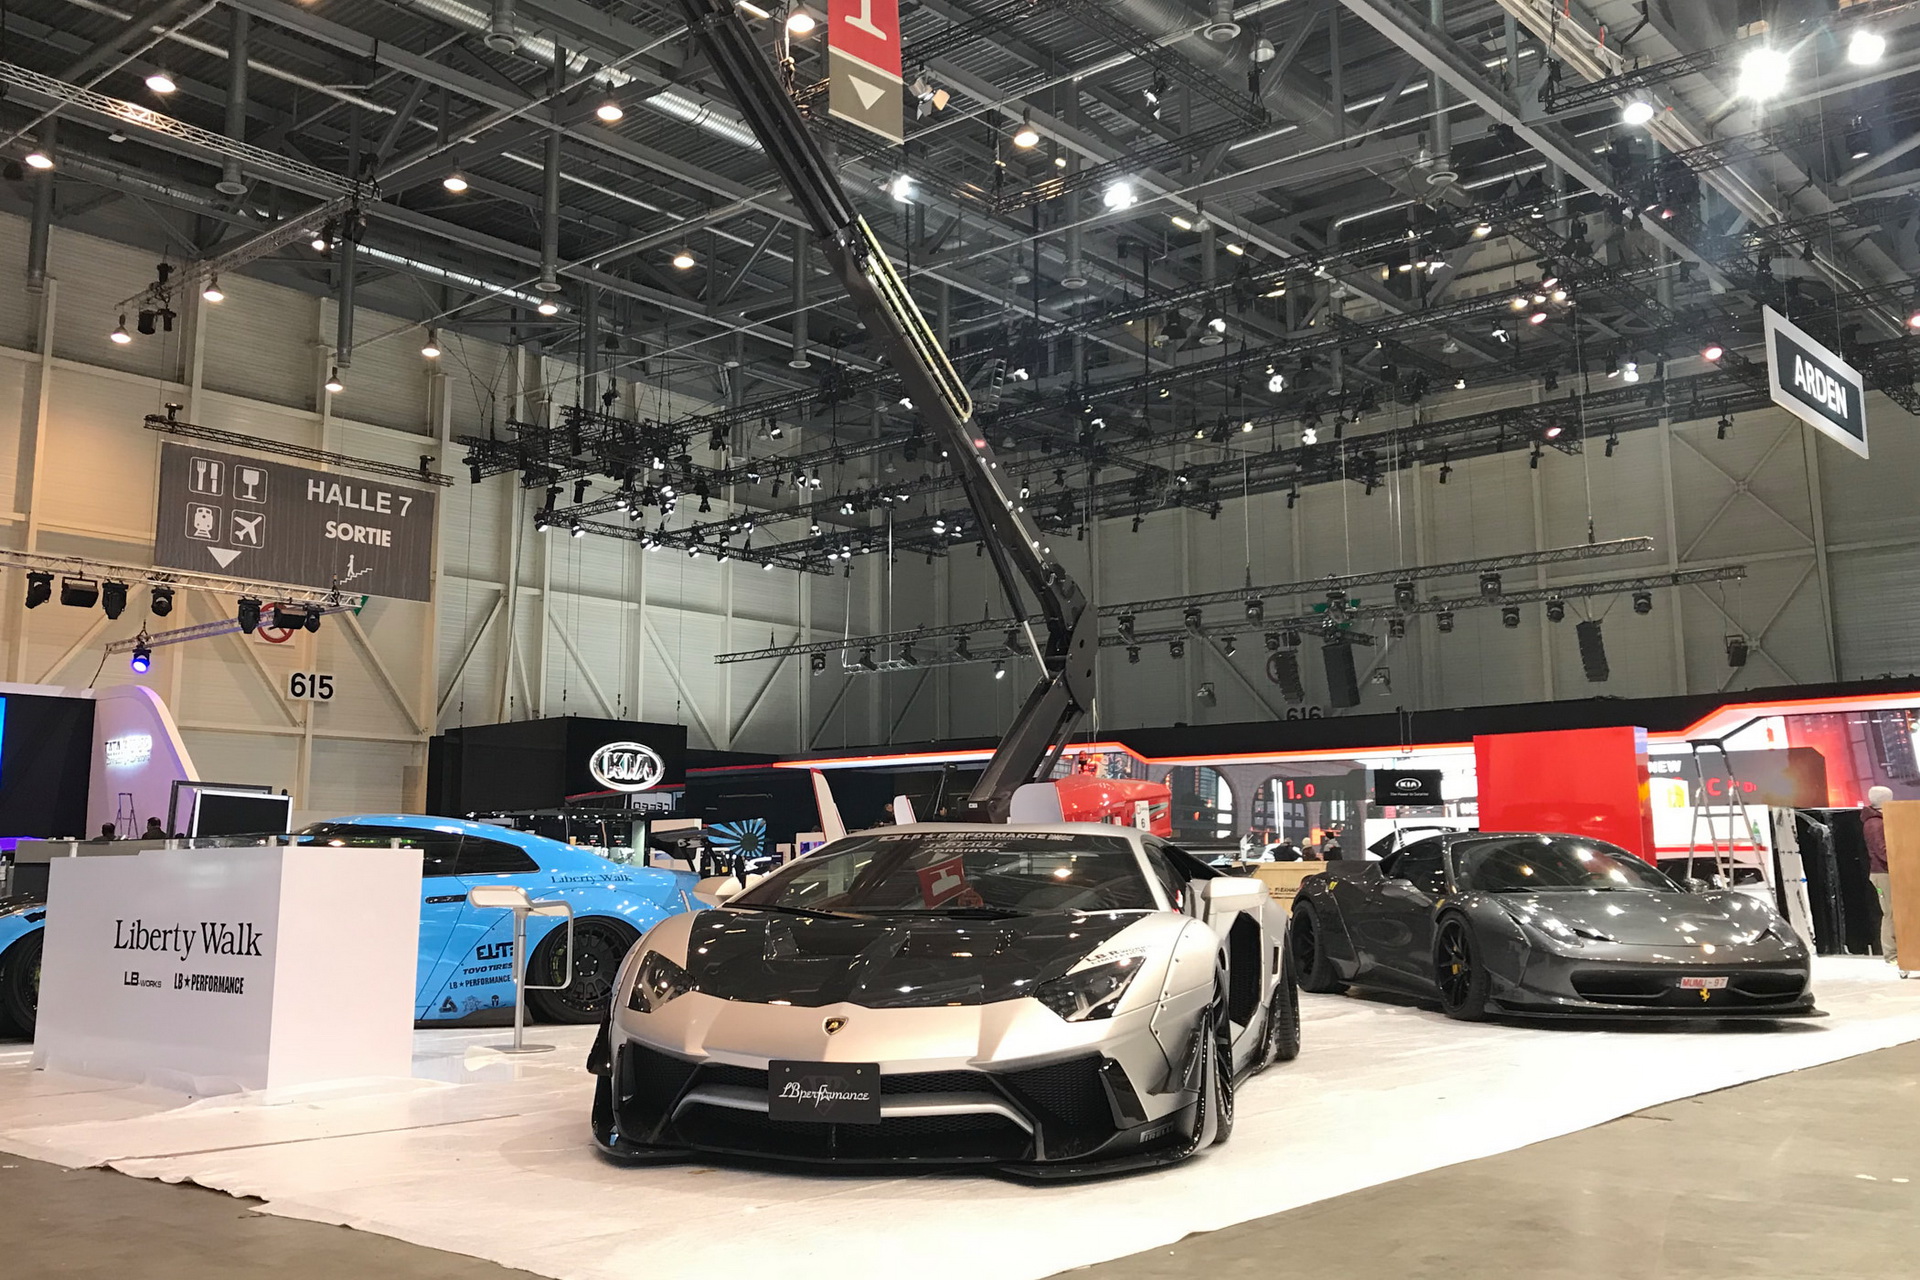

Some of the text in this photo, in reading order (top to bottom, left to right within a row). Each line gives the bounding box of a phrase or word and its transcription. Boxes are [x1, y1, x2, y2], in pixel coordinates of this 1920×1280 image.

[1794, 354, 1848, 419] ARDEN
[307, 479, 413, 517] HALLE 7
[325, 520, 392, 547] SORTIE
[290, 672, 334, 699] 615
[602, 752, 655, 781] KIA
[938, 832, 1047, 840] PERFORMANCE
[600, 874, 633, 882] Walk
[114, 919, 263, 962] Liberty Walk
[449, 974, 511, 990] LB PERFORMANCE
[463, 966, 488, 975] TOYO
[190, 974, 245, 995] PERFORMANCE
